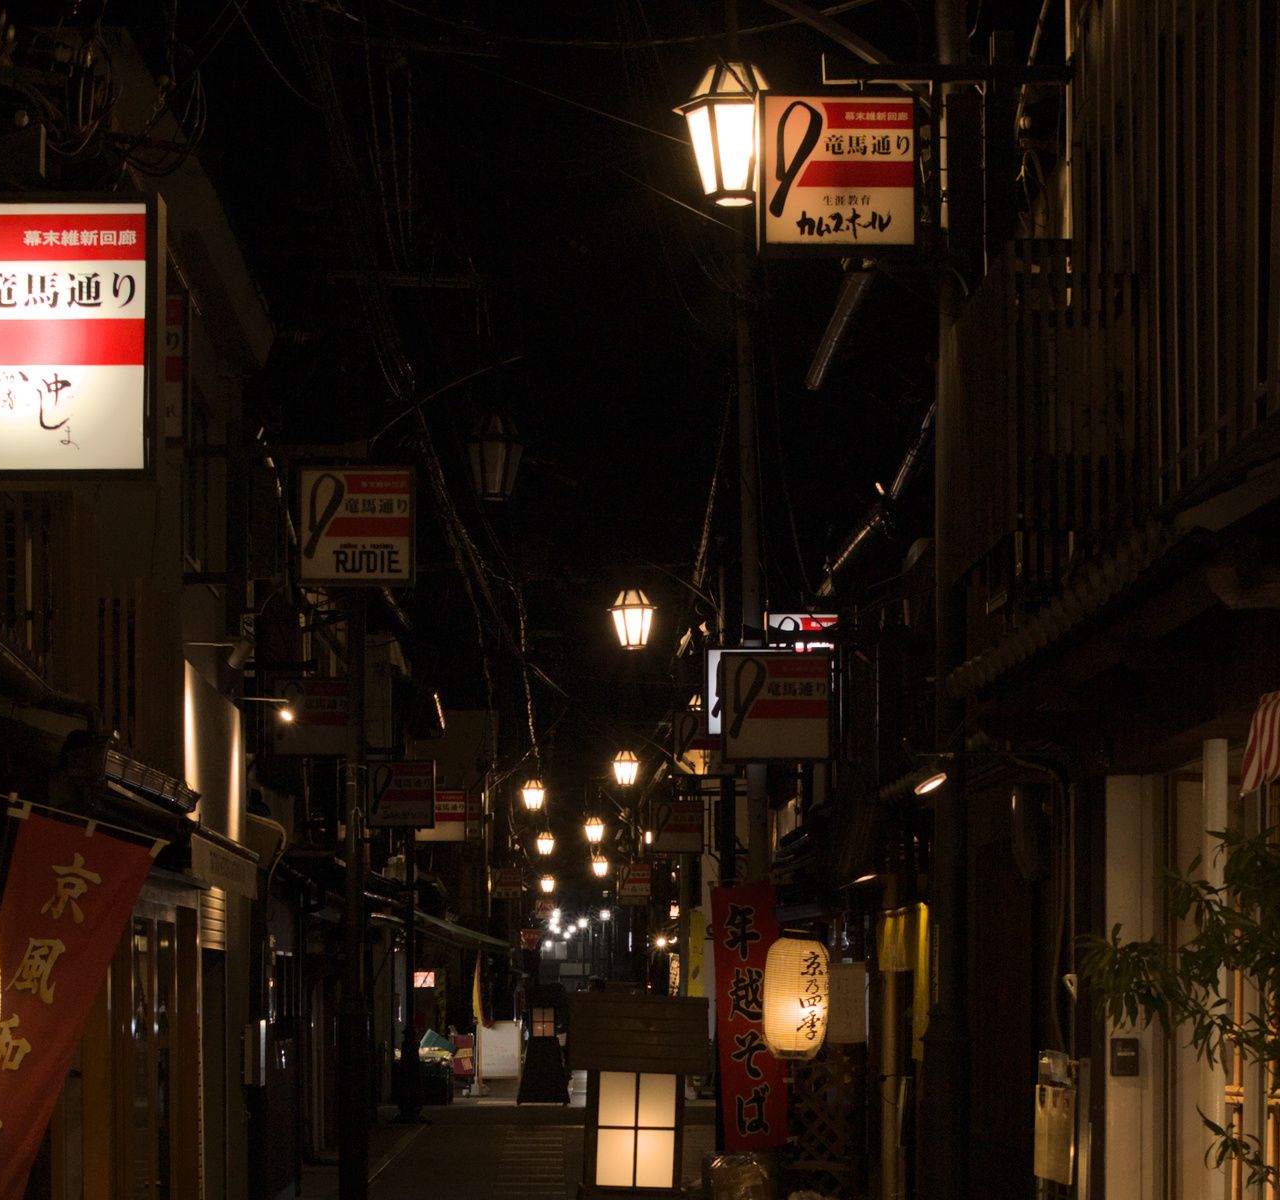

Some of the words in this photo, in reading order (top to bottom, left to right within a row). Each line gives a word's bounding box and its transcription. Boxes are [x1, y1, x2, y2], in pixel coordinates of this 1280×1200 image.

[824, 134, 911, 156] 竜馬通り
[823, 195, 871, 206] 生涯教育
[22, 229, 138, 247] 幕末維新回廊
[345, 498, 407, 514] 竜馬通り
[332, 550, 402, 573] RUDIE
[723, 902, 771, 1138] 年越そば
